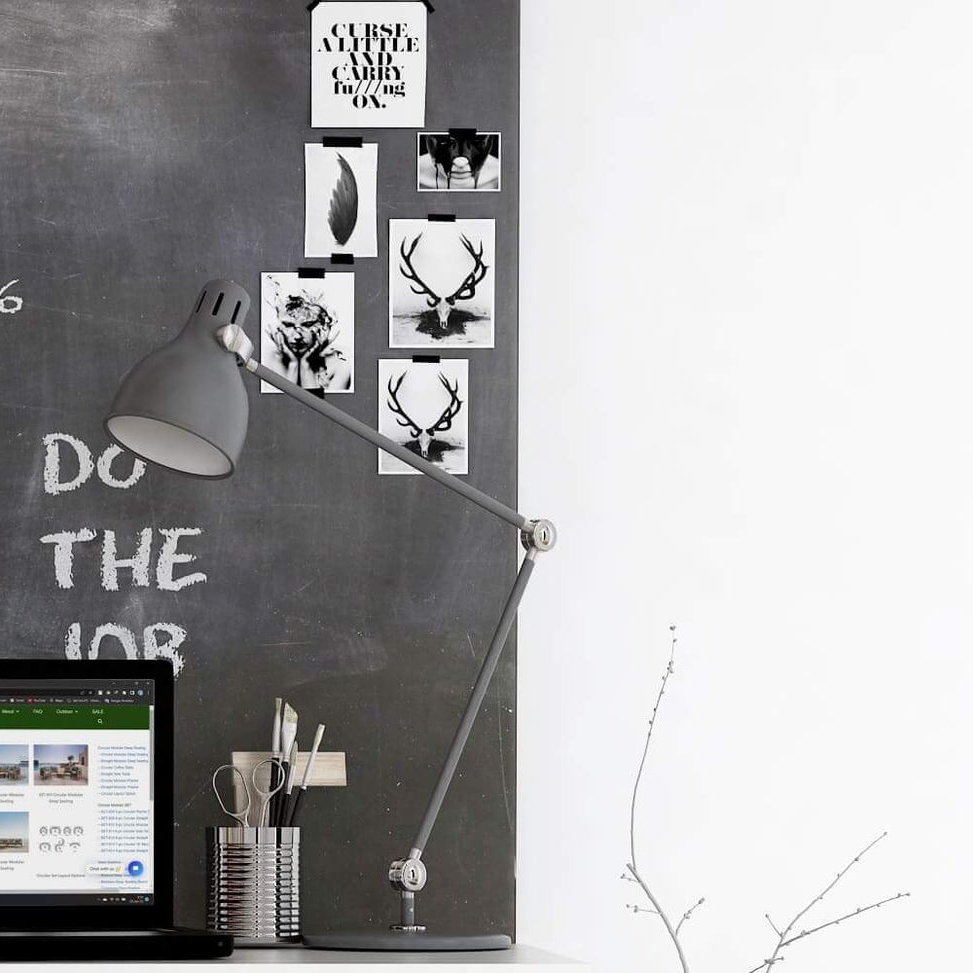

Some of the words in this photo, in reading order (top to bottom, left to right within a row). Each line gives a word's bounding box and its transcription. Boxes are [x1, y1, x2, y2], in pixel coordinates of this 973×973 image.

[331, 23, 408, 38] CURSE
[339, 37, 419, 52] LITTLE
[344, 52, 393, 66] AND
[331, 66, 405, 81] CARRY
[352, 94, 387, 109] ON.
[42, 432, 148, 496] DO
[38, 527, 208, 592] THE
